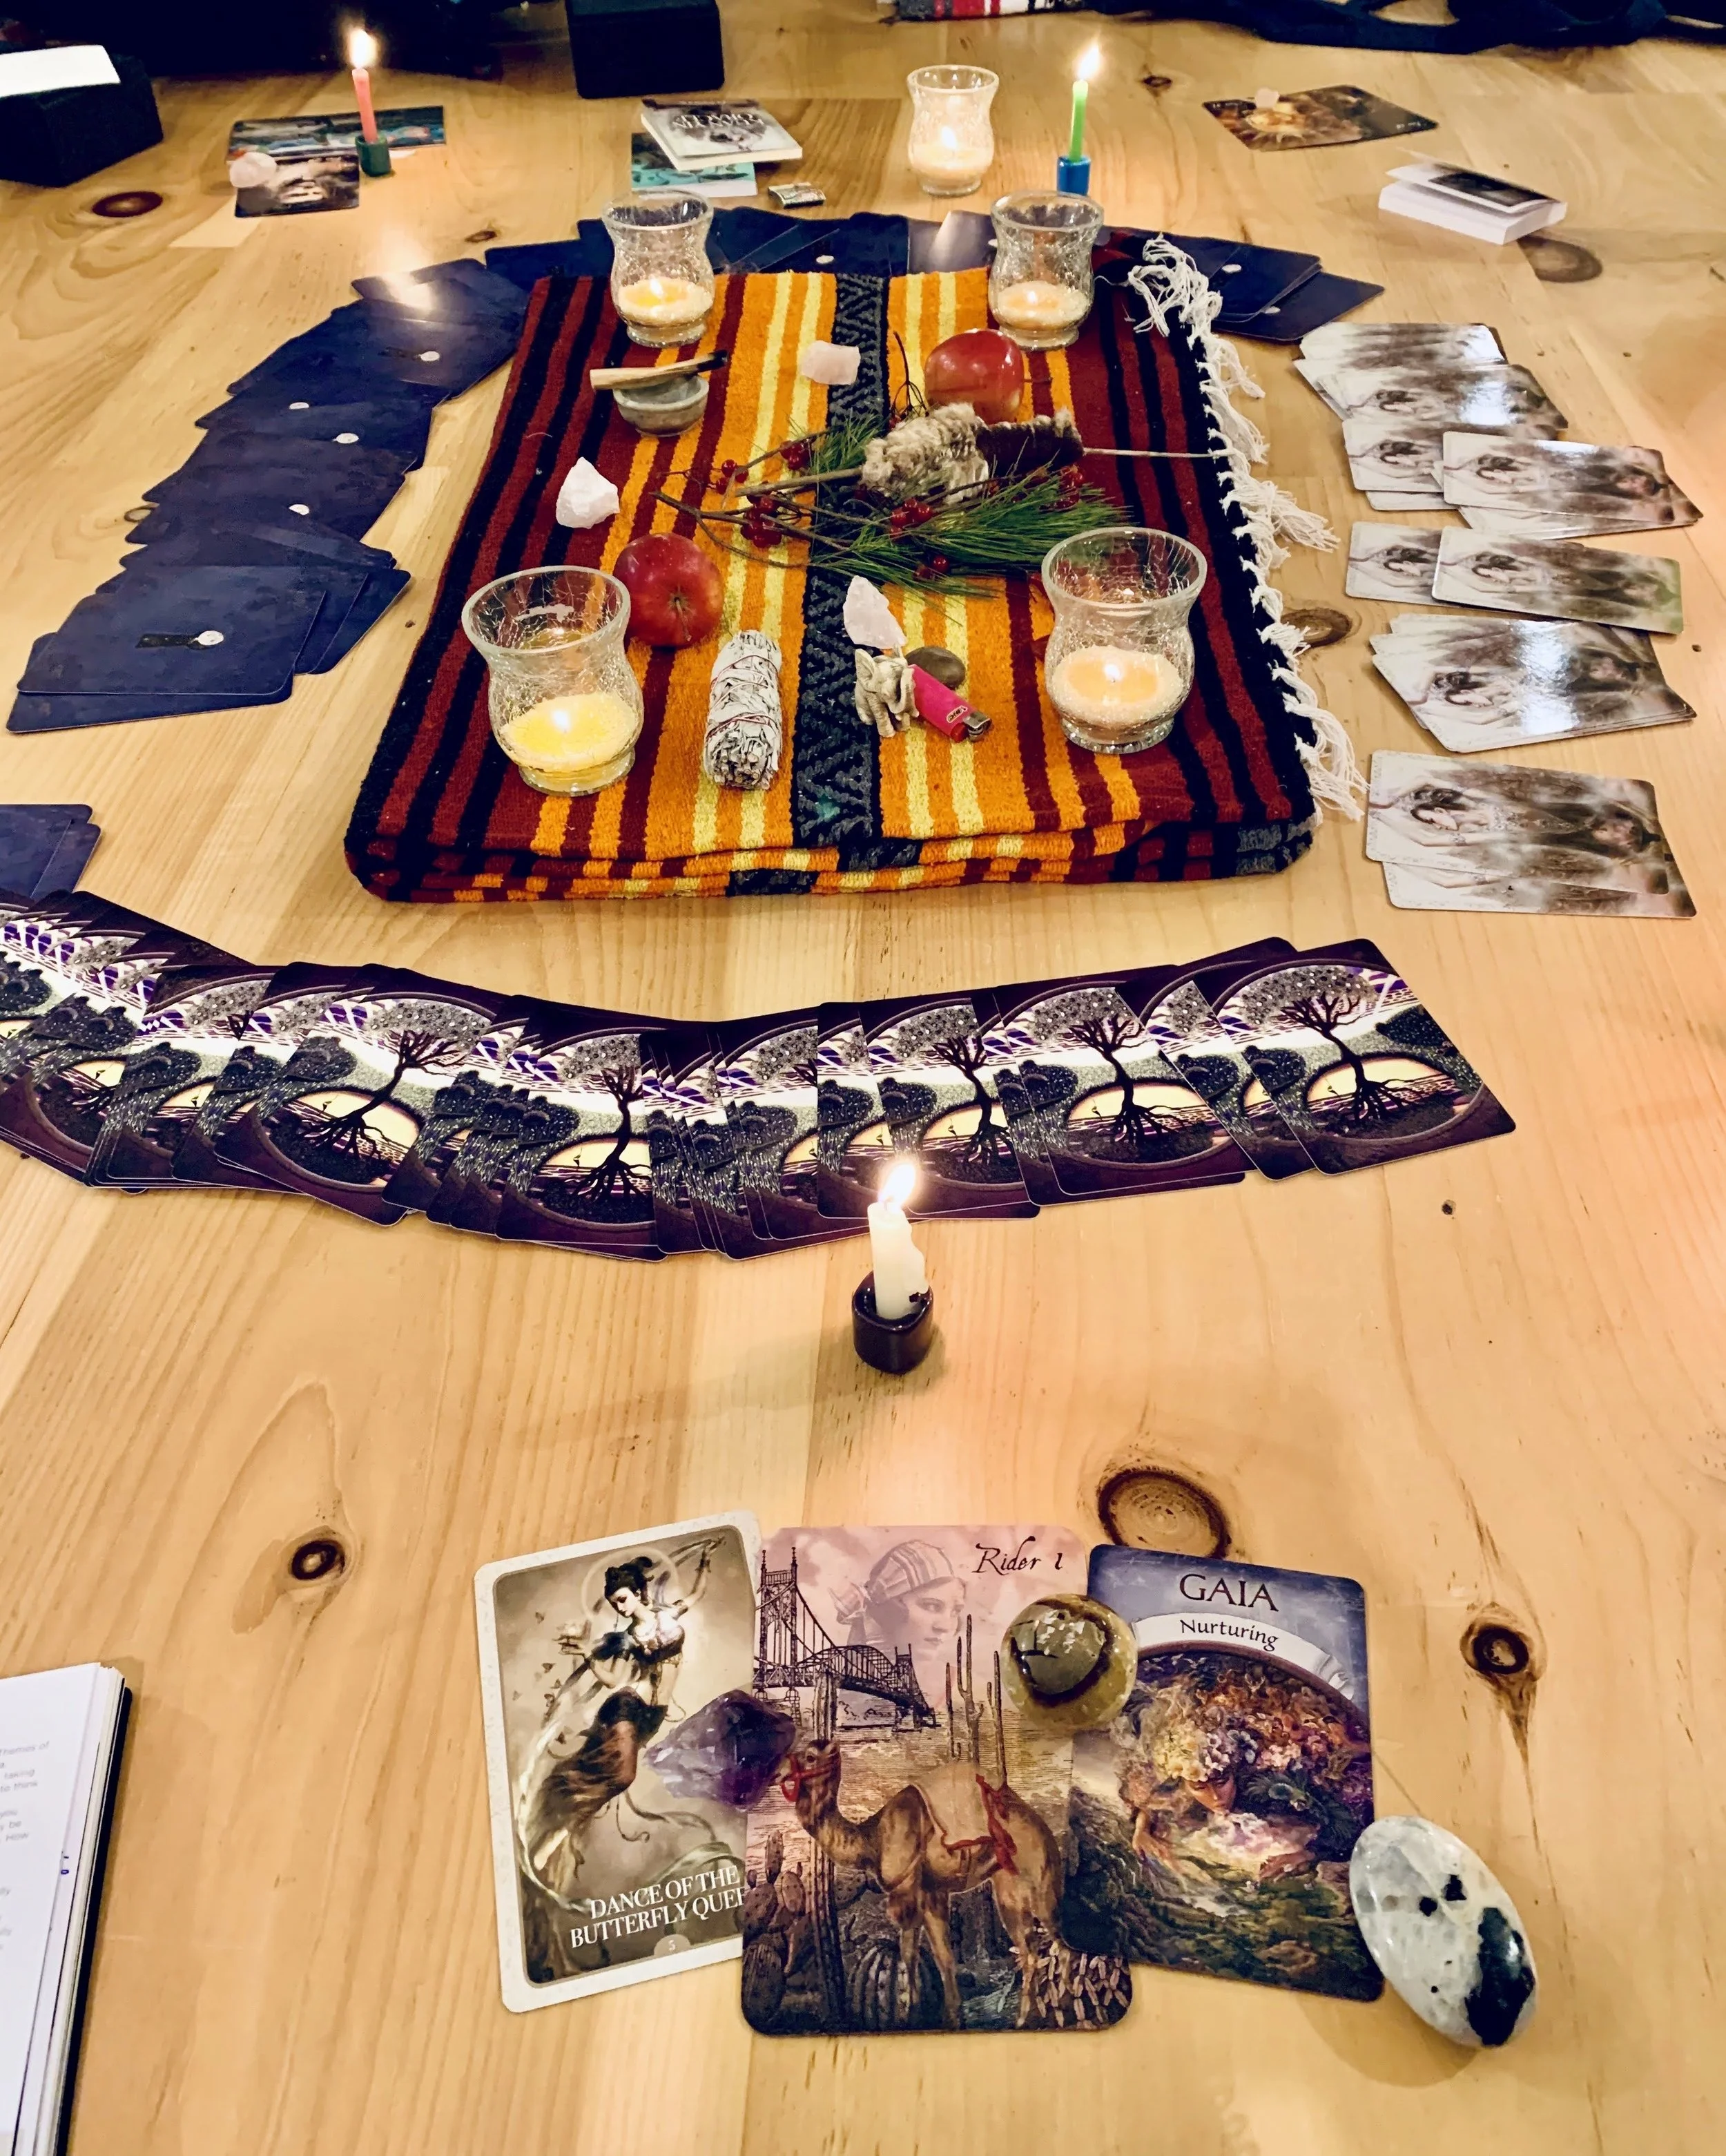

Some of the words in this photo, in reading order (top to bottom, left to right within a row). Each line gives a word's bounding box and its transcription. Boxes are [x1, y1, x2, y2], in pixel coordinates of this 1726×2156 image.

[971, 1535, 1041, 1576] Rider
[1179, 1573, 1279, 1612] GAIA
[1180, 1618, 1279, 1651] Nurturing
[590, 1883, 662, 1920] DANCE
[665, 1876, 694, 1900] OF
[692, 1865, 741, 1892] THE
[570, 1900, 689, 1949] BUTTERFLY
[668, 1940, 676, 1952] 5
